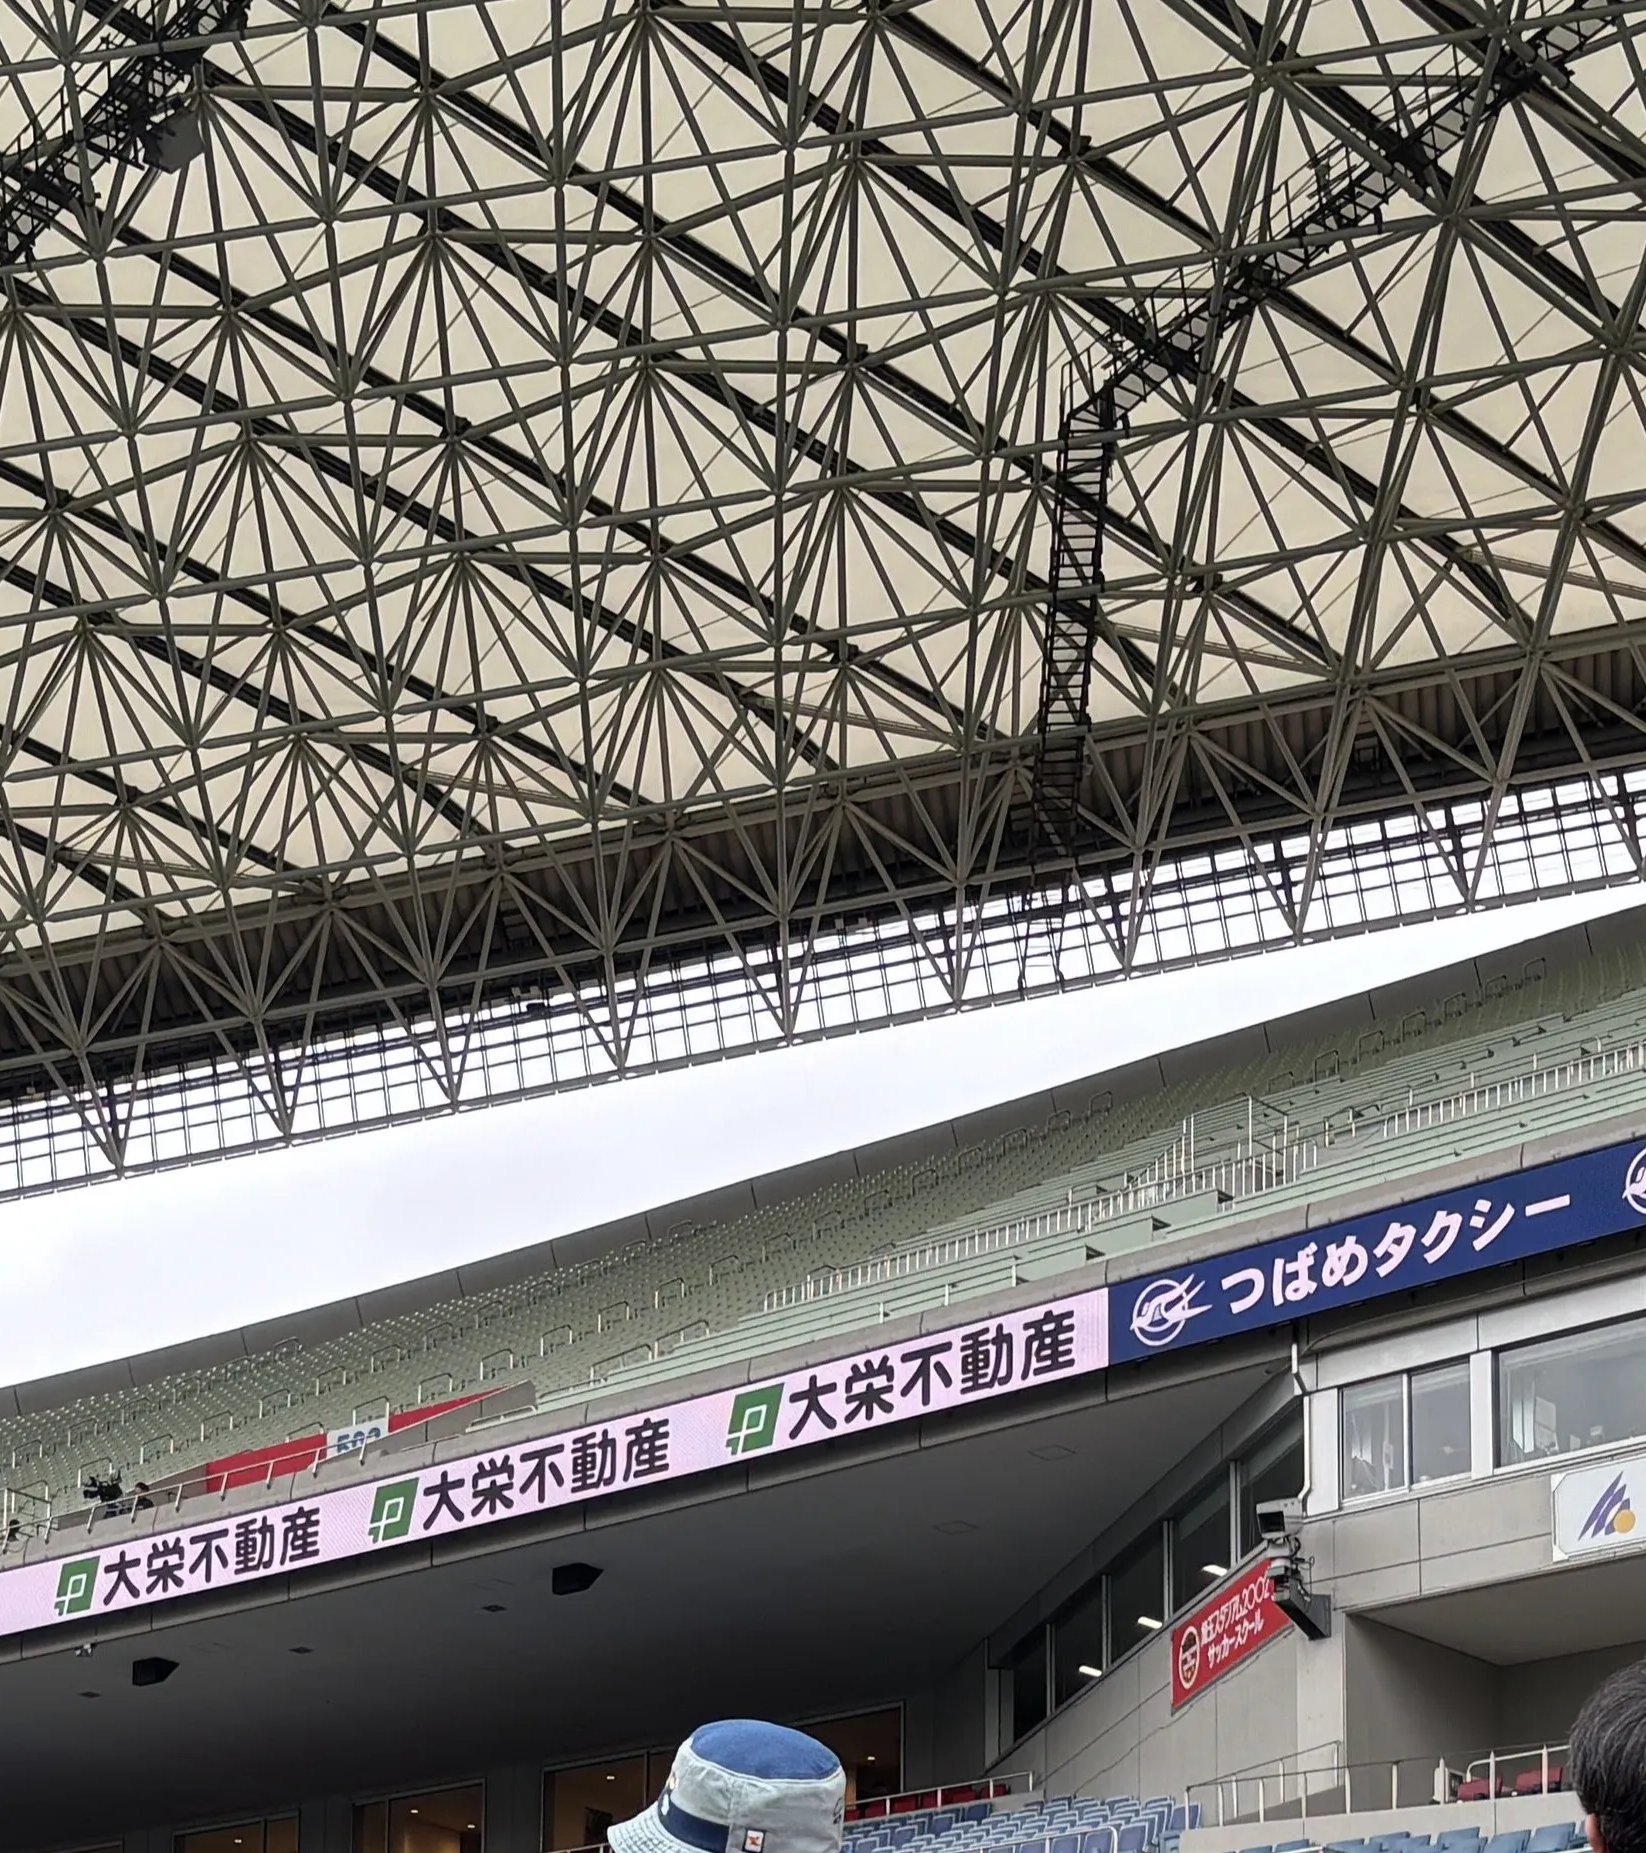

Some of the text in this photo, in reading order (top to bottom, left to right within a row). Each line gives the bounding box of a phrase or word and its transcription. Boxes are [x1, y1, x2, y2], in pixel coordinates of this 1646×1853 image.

[1222, 1195, 1570, 1314] つばめタクシー
[790, 1310, 1076, 1440] 大栄不動産
[423, 1416, 669, 1531] 大栄不動産
[103, 1506, 321, 1605] 大栄不動産
